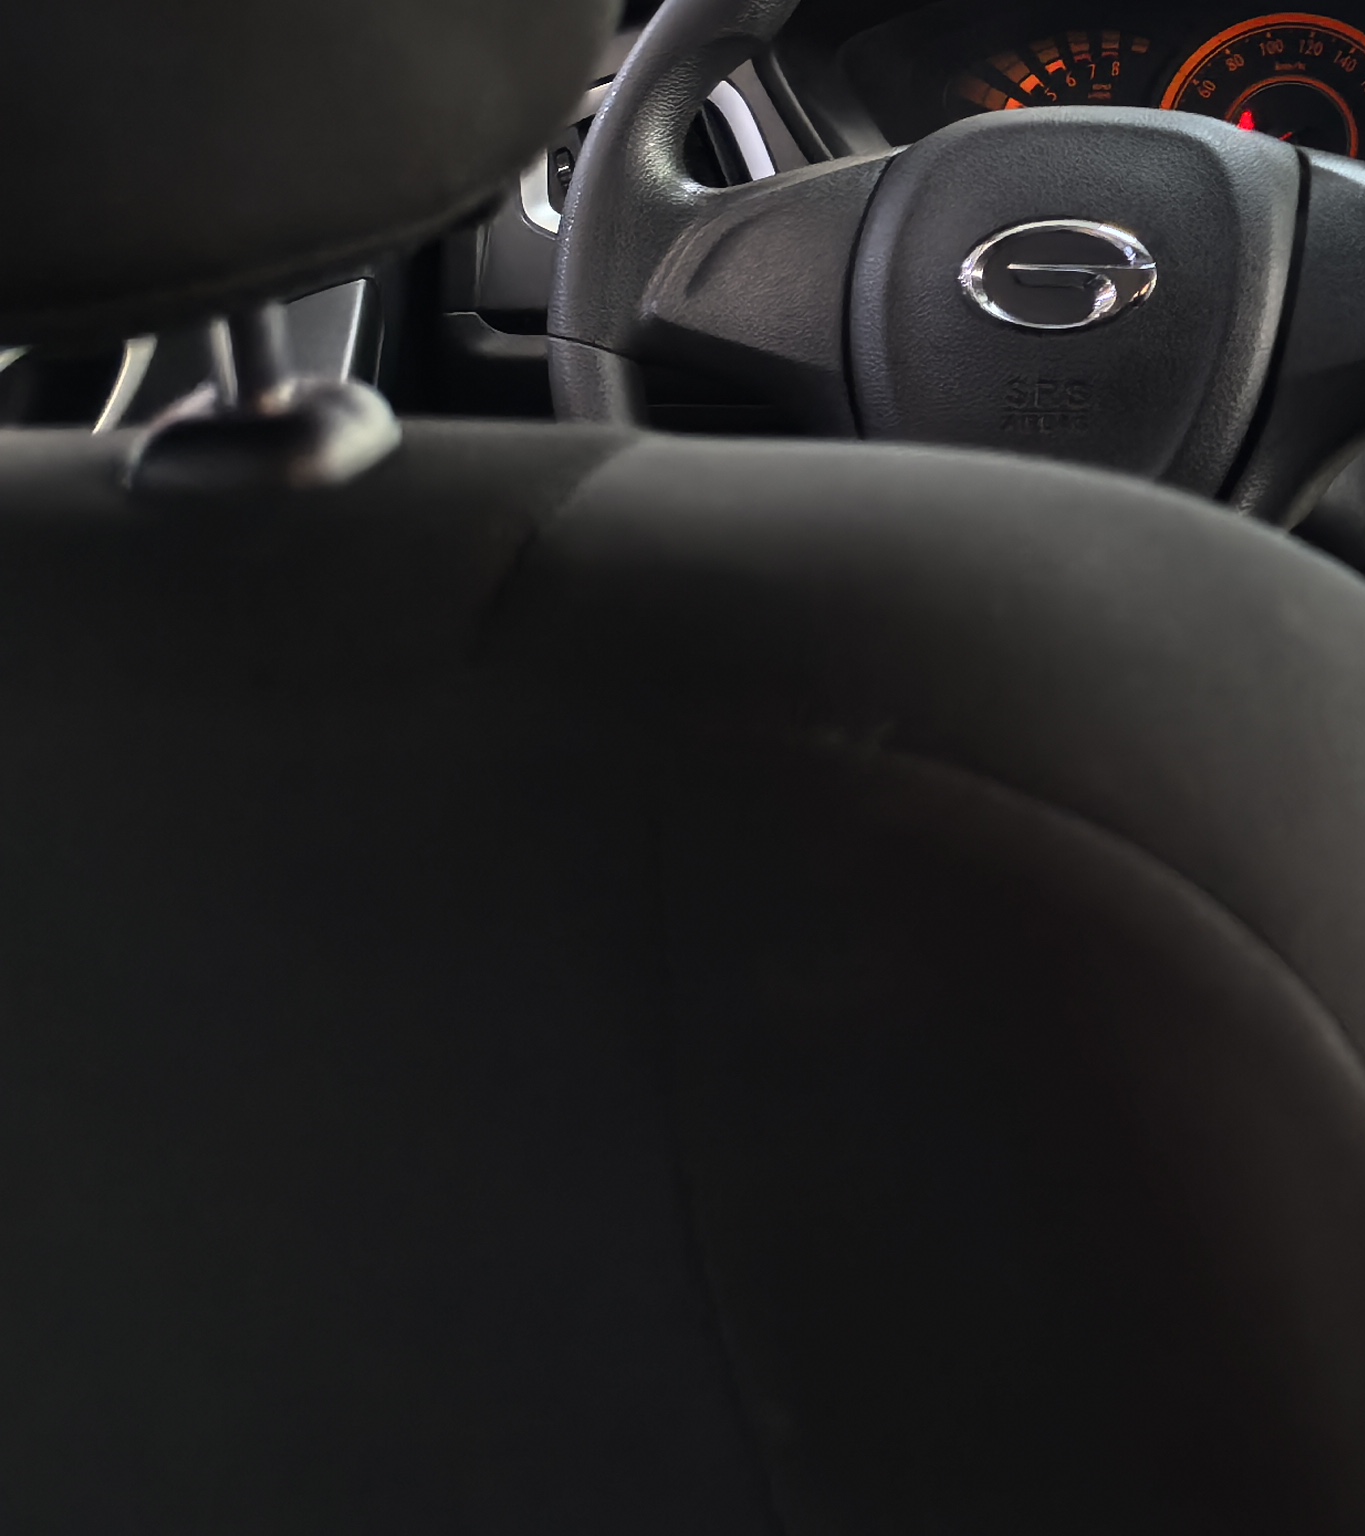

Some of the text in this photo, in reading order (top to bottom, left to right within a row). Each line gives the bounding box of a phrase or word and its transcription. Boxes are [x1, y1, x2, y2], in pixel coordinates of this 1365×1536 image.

[1259, 39, 1284, 56] 100
[1299, 39, 1324, 56] 120
[1111, 61, 1120, 76] 8
[1225, 53, 1245, 72] 80
[1334, 49, 1357, 73] 140
[1088, 64, 1096, 79] 7
[1066, 74, 1077, 87] 6
[1199, 79, 1218, 99] 60
